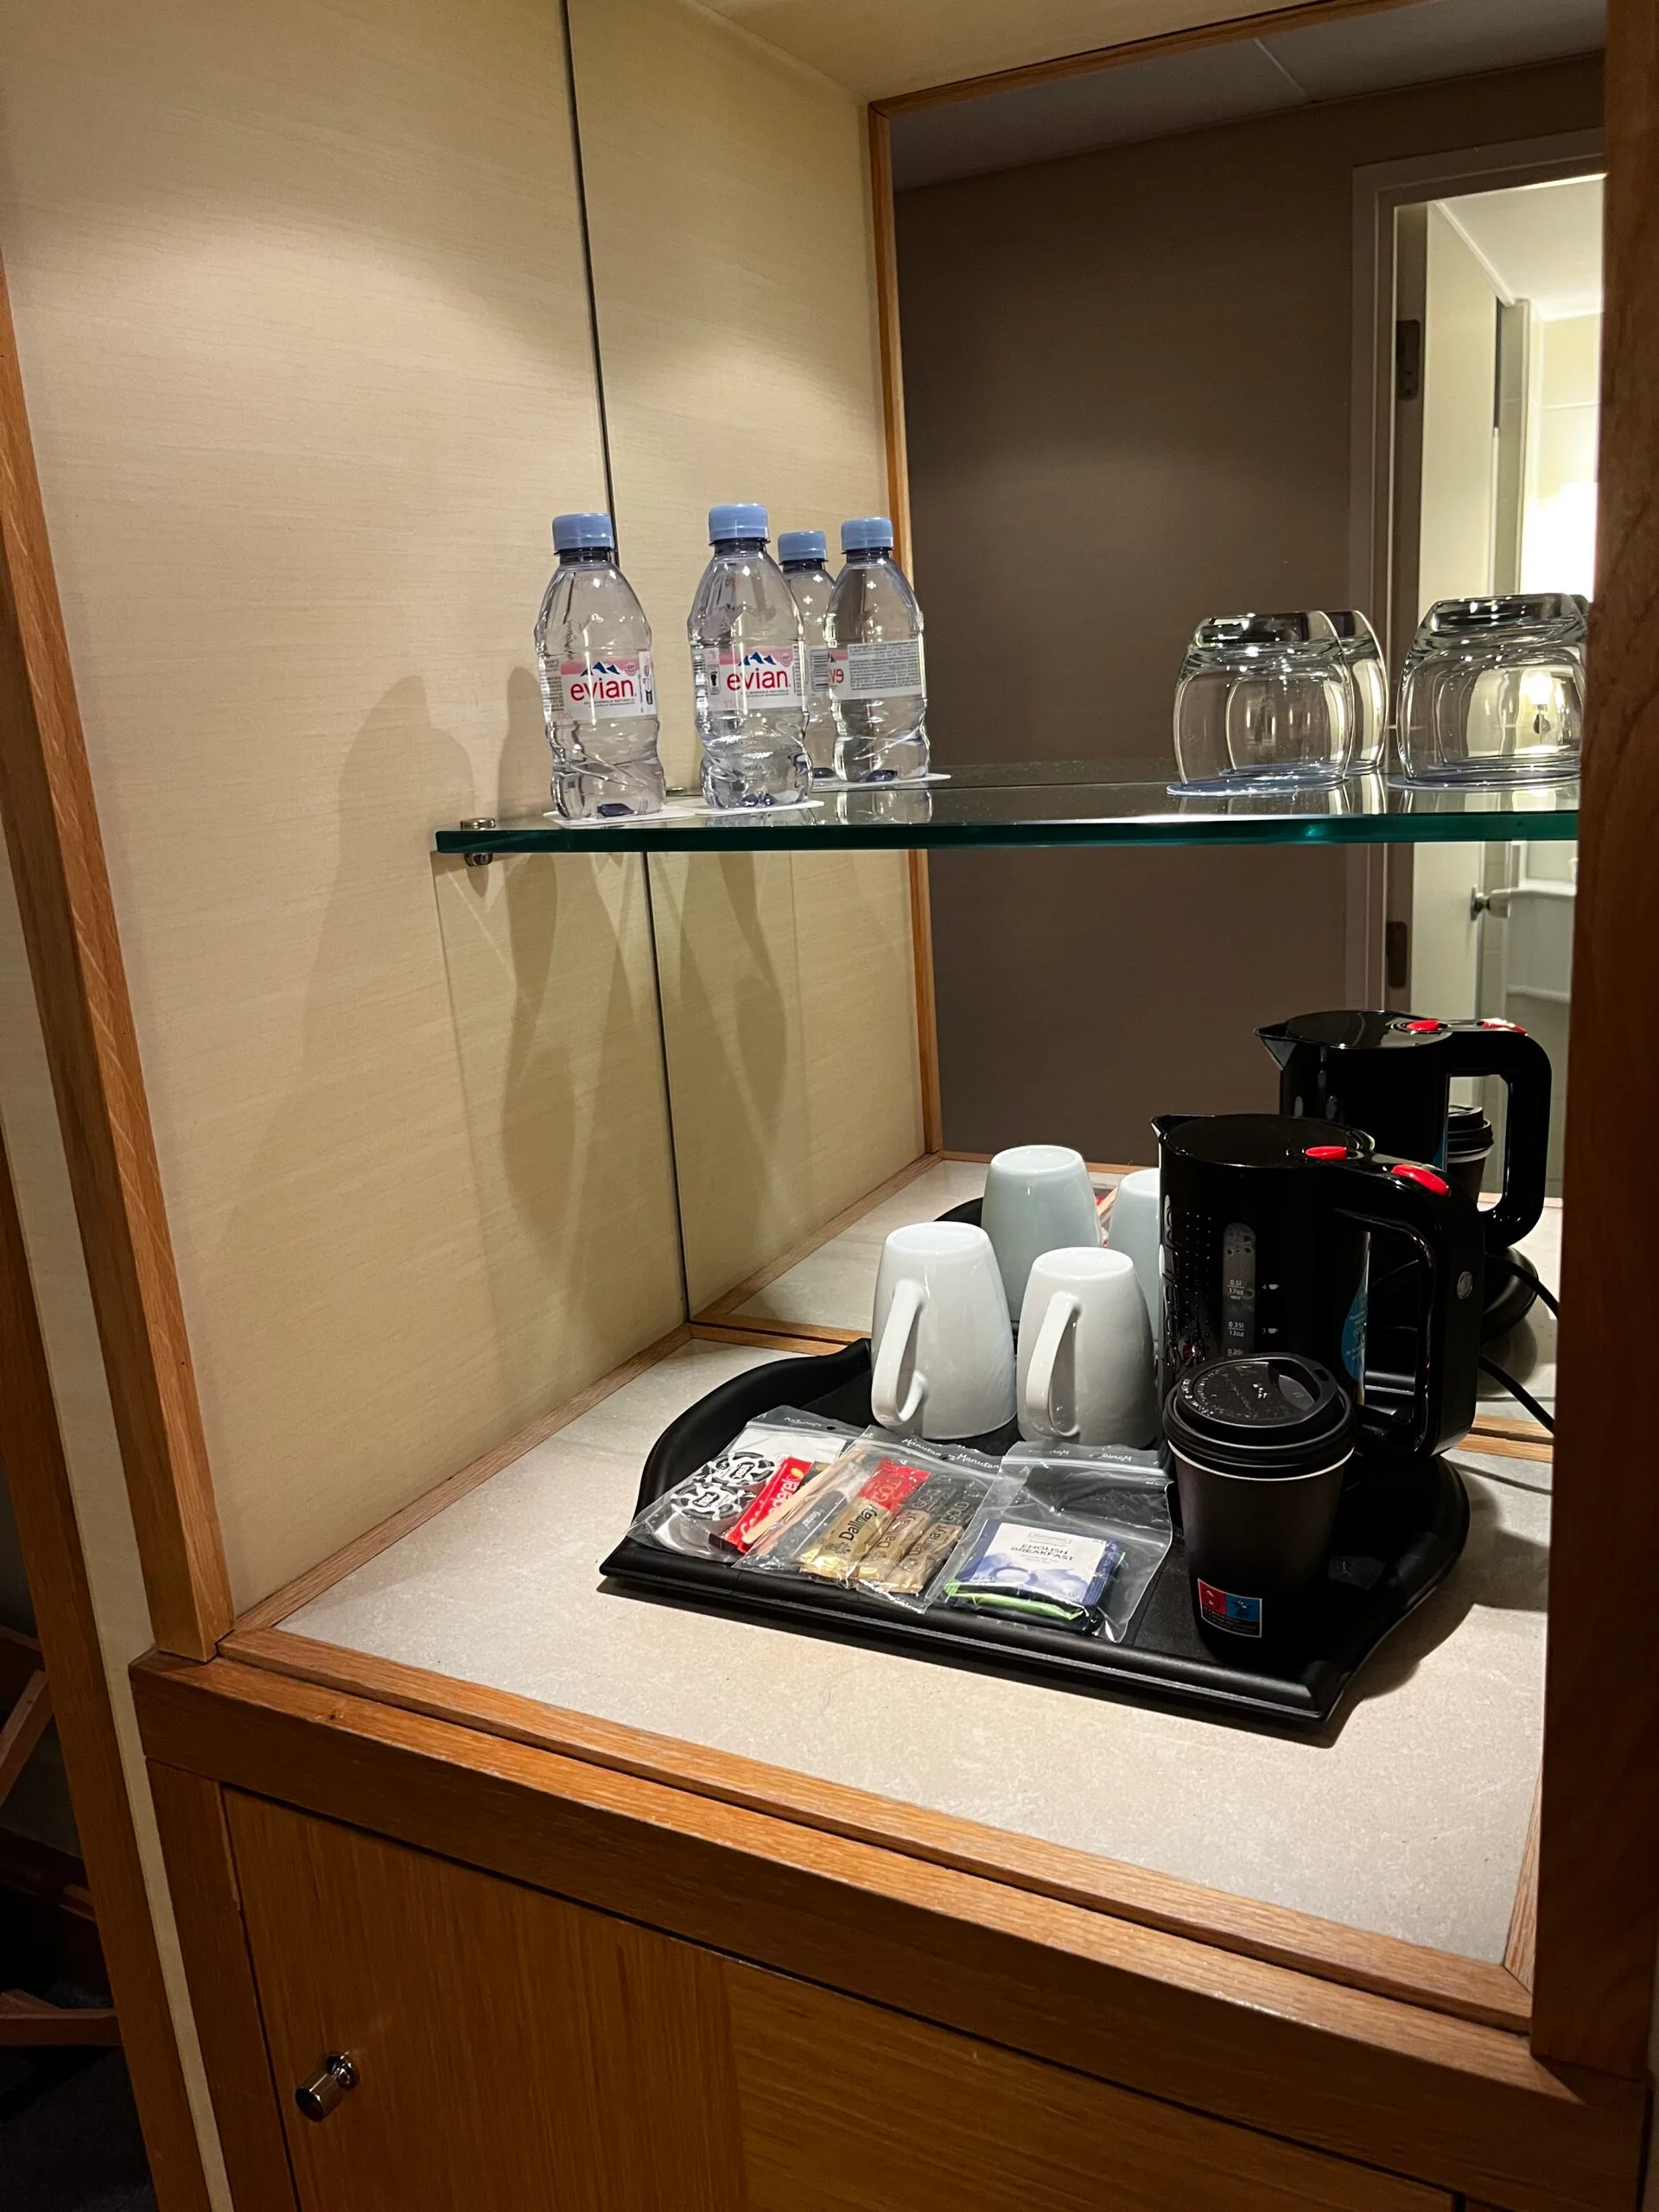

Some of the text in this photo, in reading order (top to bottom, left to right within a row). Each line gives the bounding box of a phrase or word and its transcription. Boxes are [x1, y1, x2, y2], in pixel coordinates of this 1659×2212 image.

[570, 677, 634, 701] evian
[727, 668, 789, 691] evian
[901, 1438, 943, 1457] Manutan
[838, 1503, 879, 1541] Dallmayr
[1010, 1547, 1075, 1561] BREAKFAST
[1021, 1544, 1068, 1555] ENGLISH
